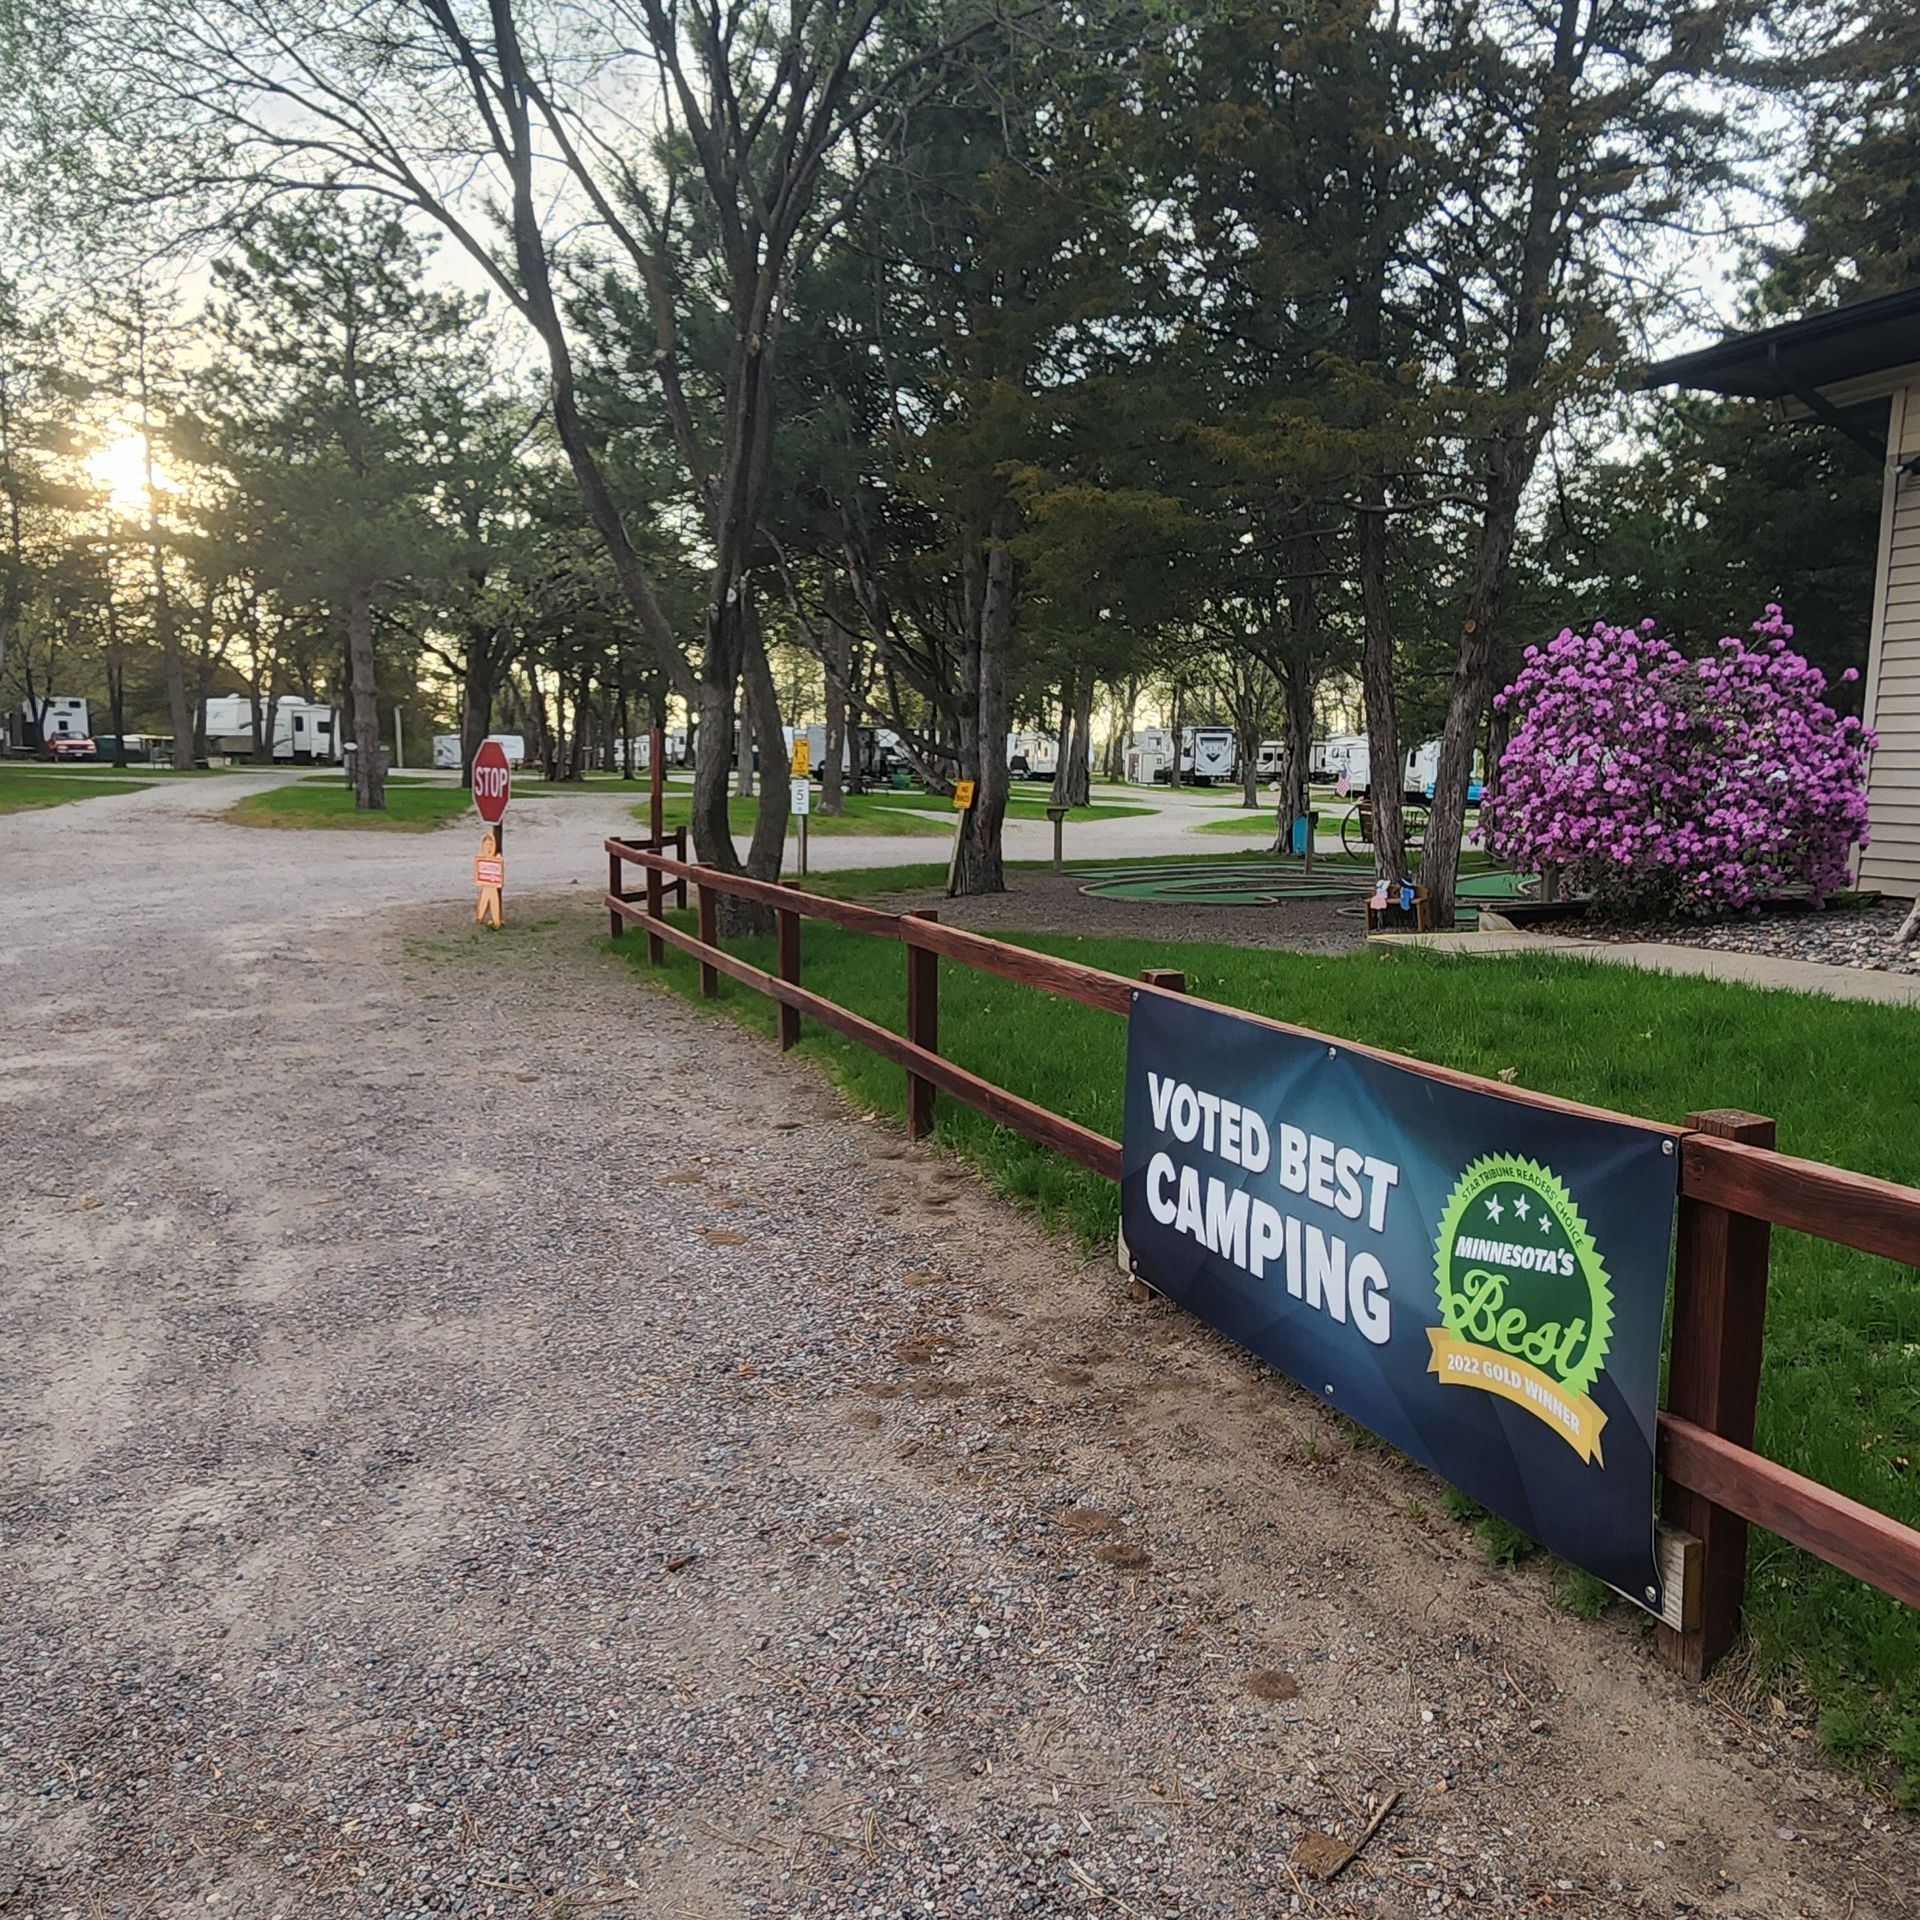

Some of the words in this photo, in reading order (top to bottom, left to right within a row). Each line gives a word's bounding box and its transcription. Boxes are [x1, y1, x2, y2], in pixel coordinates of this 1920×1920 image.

[475, 766, 508, 798] STOP
[796, 789, 804, 801] 5
[1147, 1071, 1271, 1174] VOTED
[1280, 1122, 1399, 1233] BEST
[1146, 1151, 1391, 1345] CAMPING
[1462, 1177, 1481, 1201] STAR
[1480, 1167, 1515, 1184] TRIBUNE
[1516, 1168, 1558, 1200] READERS'
[1555, 1201, 1584, 1248] CHOICE
[1455, 1235, 1575, 1277] MINNESOTA'S
[1450, 1269, 1586, 1379] Best
[1447, 1354, 1480, 1375] 2022
[1482, 1360, 1522, 1389] GOLD
[1524, 1376, 1580, 1436] WINNER
